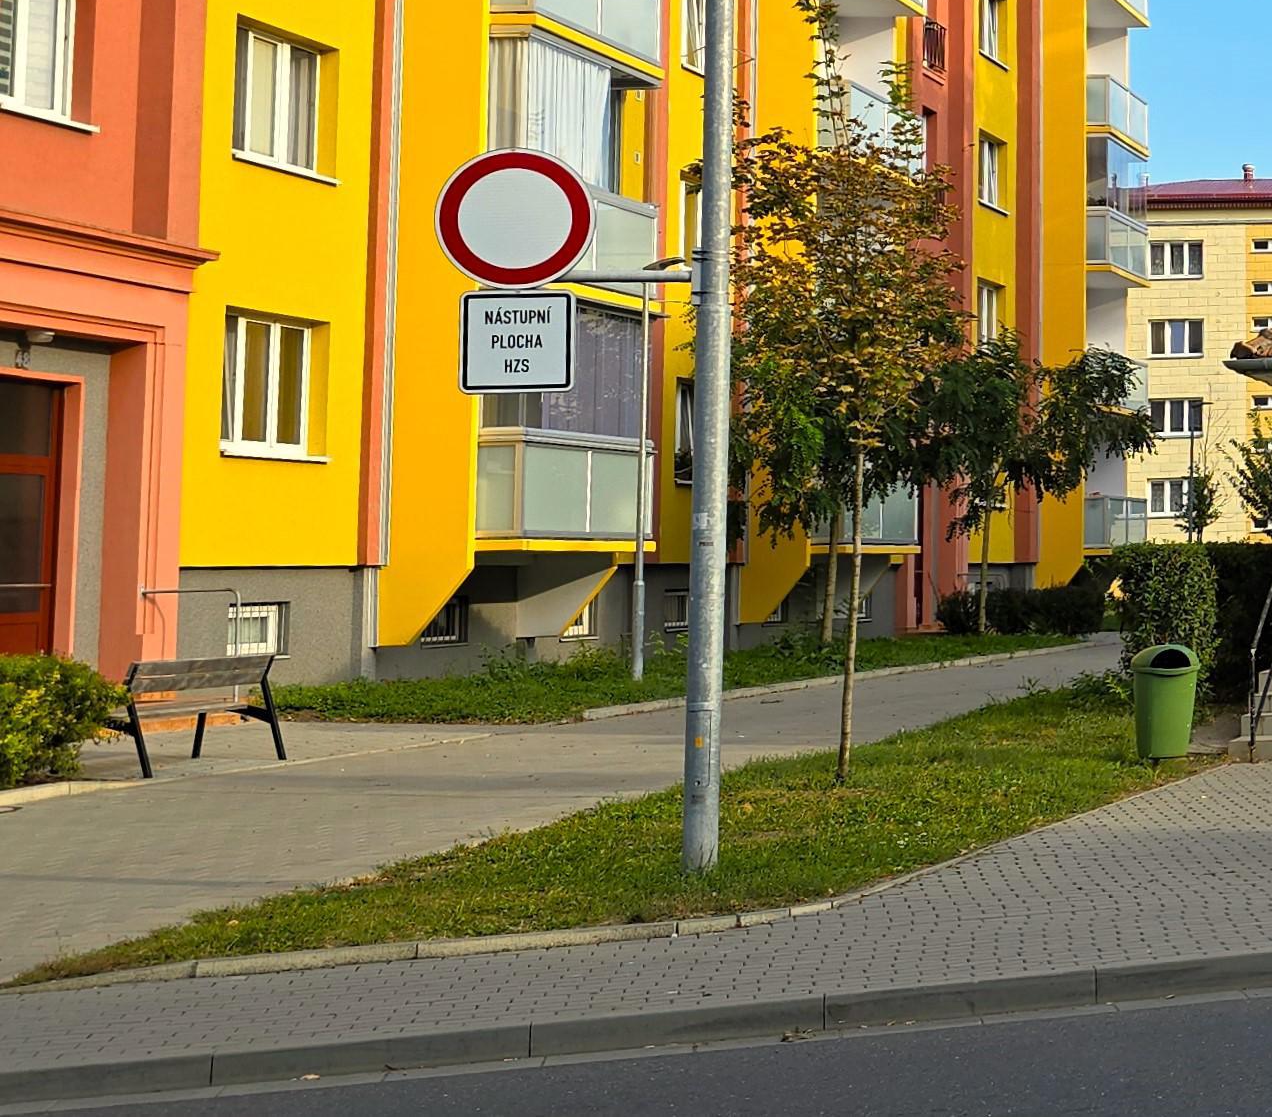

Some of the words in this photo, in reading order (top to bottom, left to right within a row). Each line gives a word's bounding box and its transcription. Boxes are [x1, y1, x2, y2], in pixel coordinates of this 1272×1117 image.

[484, 306, 552, 325] NÁSTUPNÍ
[491, 334, 543, 350] PLOCHA
[504, 358, 530, 373] HZS
